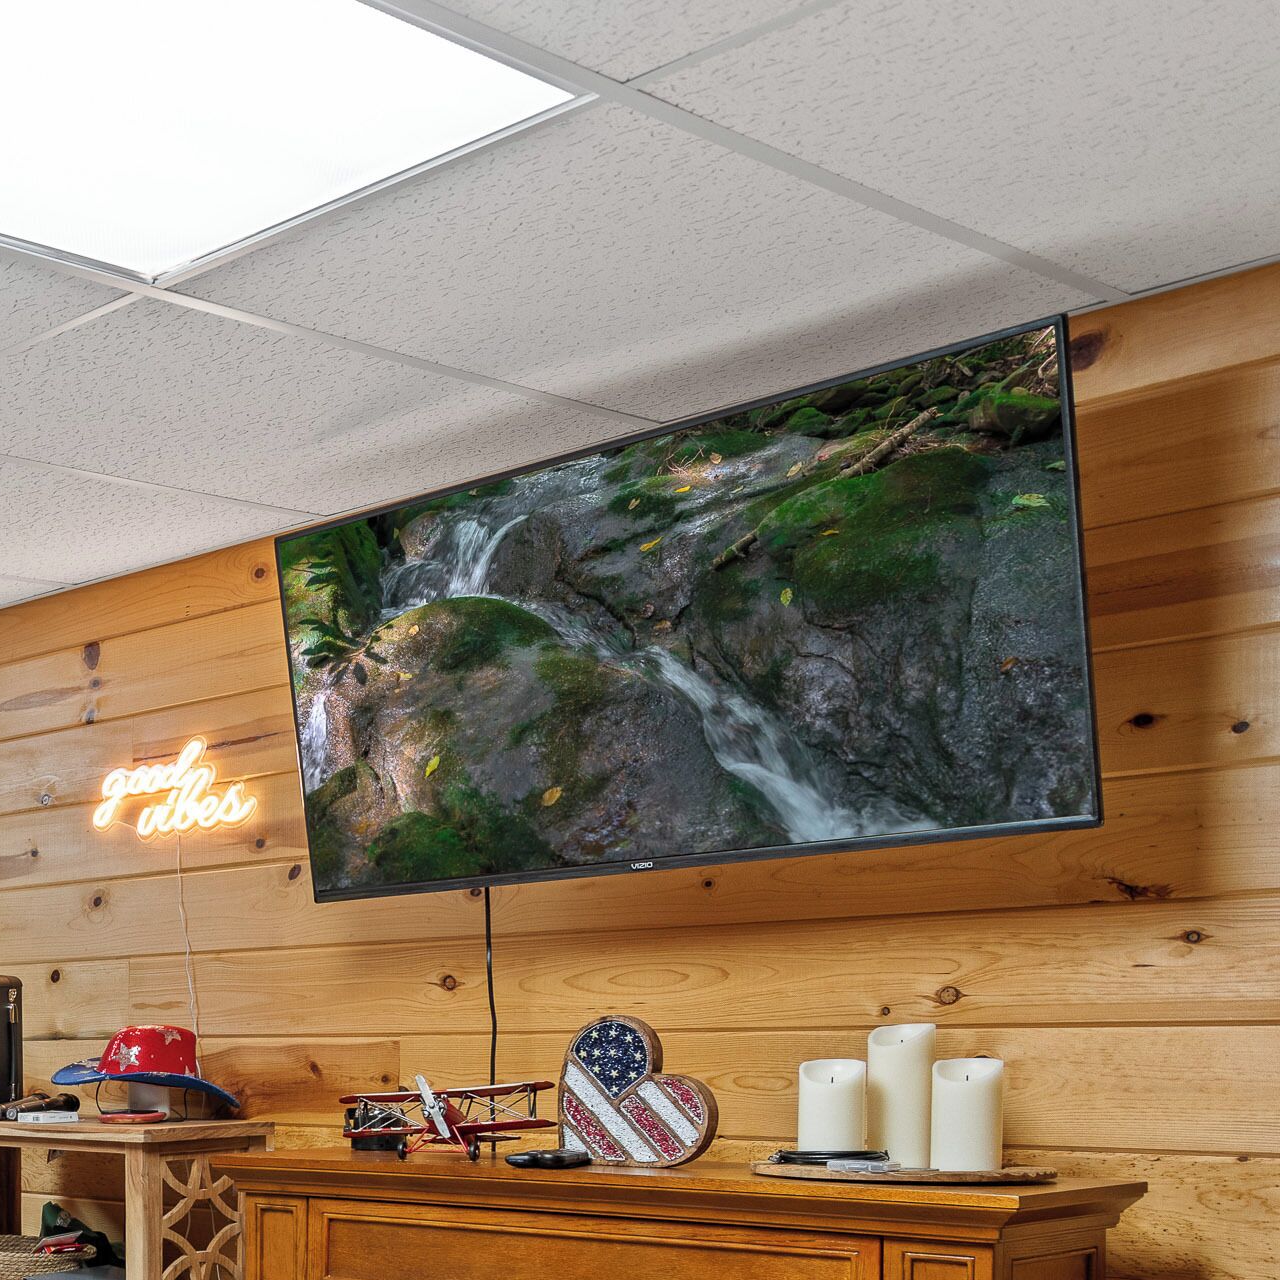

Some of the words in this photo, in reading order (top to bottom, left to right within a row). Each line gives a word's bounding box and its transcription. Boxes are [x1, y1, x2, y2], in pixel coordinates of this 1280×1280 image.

[93, 740, 203, 828] good
[137, 767, 255, 836] vibes
[630, 861, 653, 870] VIZIO
